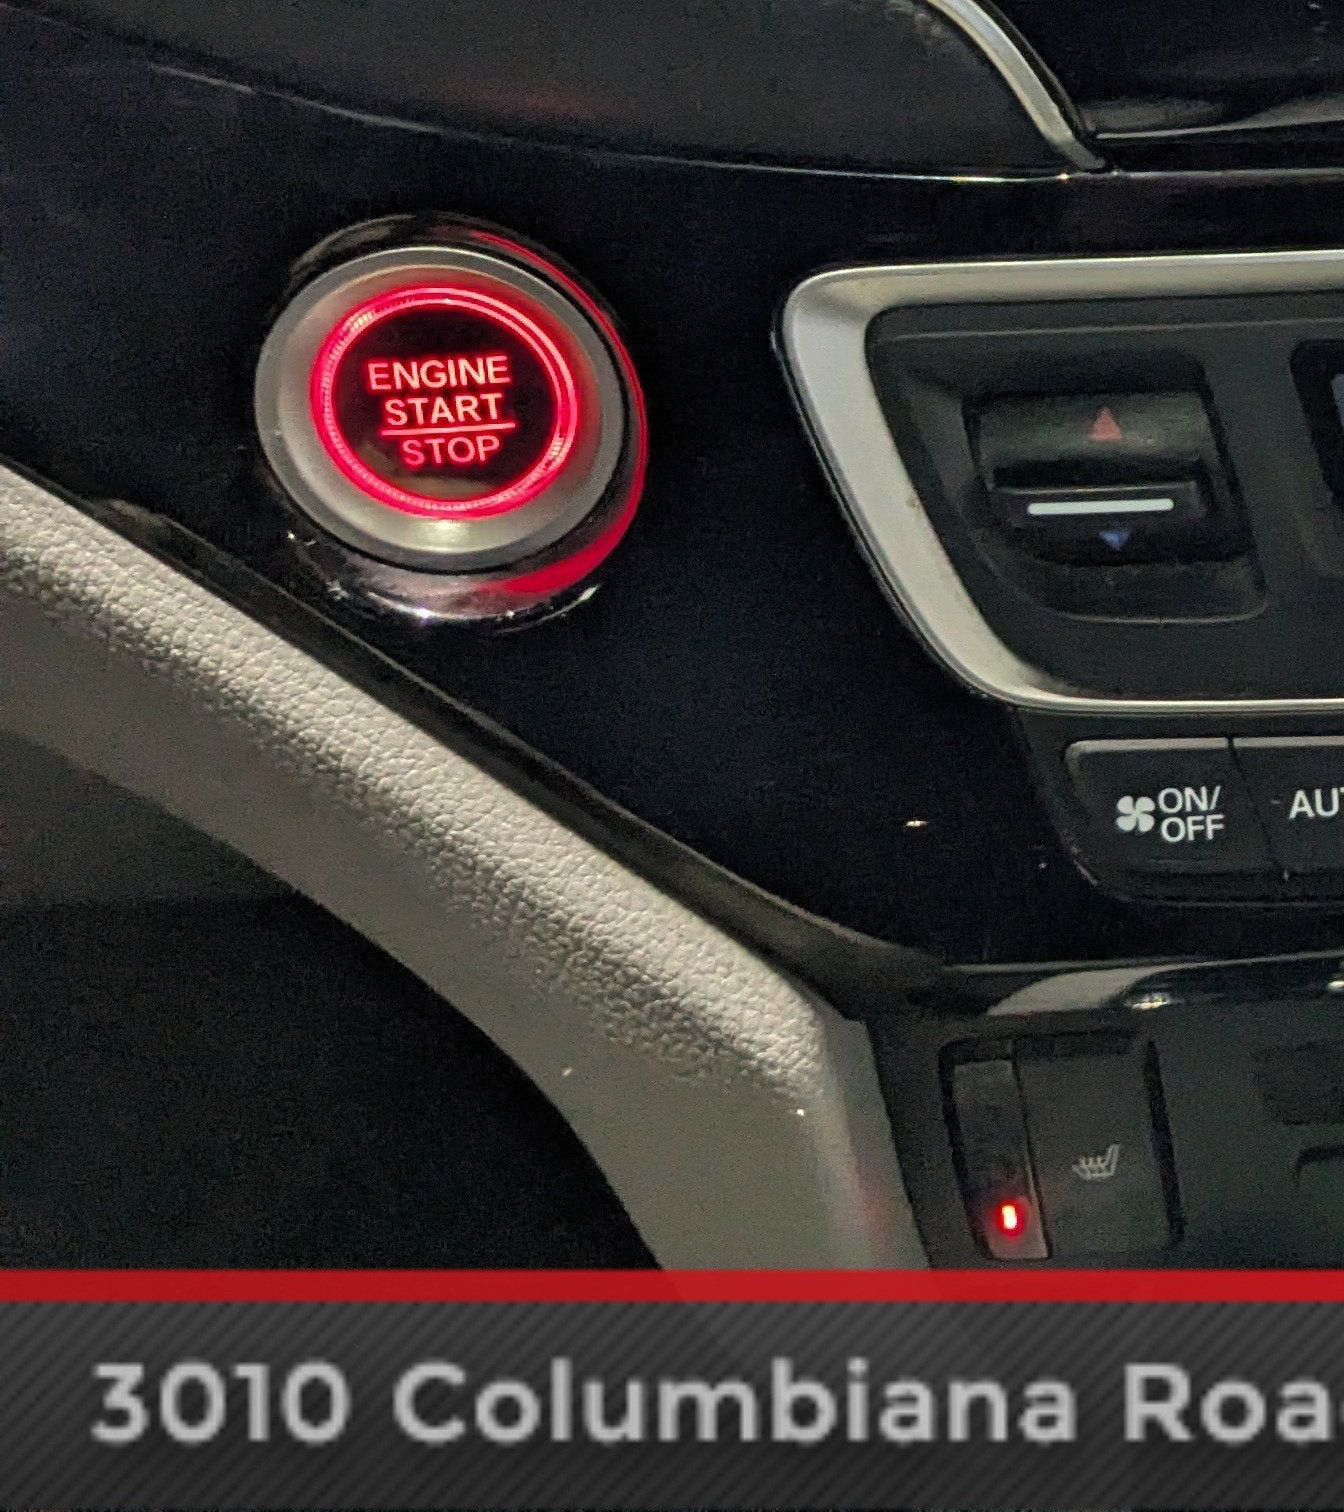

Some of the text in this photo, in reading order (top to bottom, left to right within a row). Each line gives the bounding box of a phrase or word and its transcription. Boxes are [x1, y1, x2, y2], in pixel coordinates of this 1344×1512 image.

[366, 355, 511, 391] ENGINE
[384, 392, 503, 426] START
[400, 435, 501, 467] STOP
[1155, 784, 1224, 816] ON/
[1158, 815, 1227, 844] OFF
